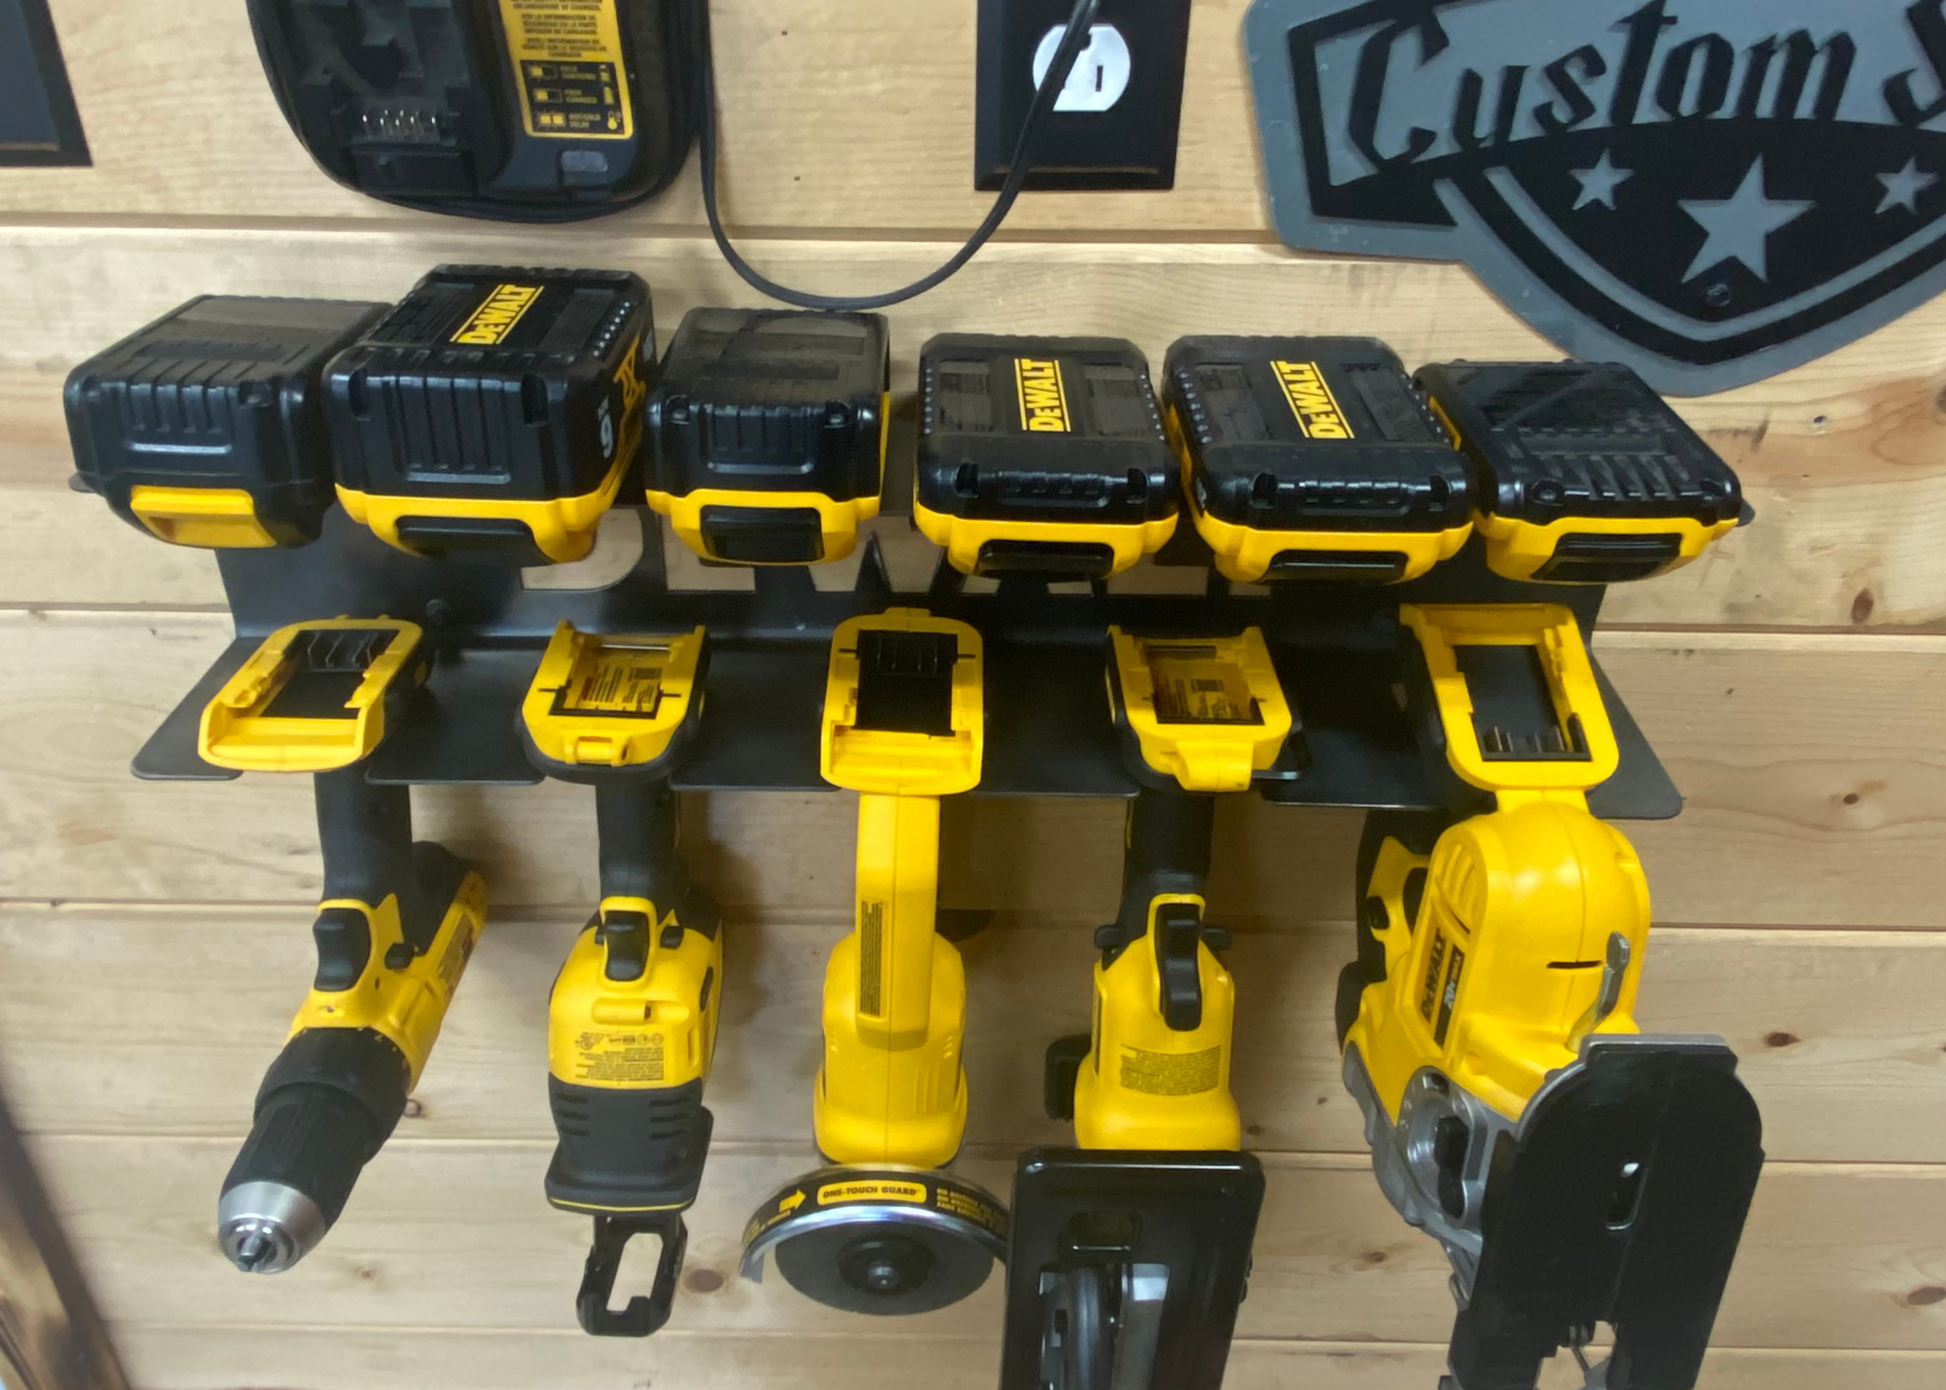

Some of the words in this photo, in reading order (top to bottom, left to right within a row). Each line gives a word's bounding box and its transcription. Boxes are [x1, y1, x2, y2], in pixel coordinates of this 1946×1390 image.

[456, 284, 538, 345] DEWALT
[1020, 358, 1065, 432] DEWALT
[1275, 360, 1349, 439] DEWALT
[823, 1186, 878, 1198] ONE-TOUCH
[881, 1186, 917, 1196] GUARD
